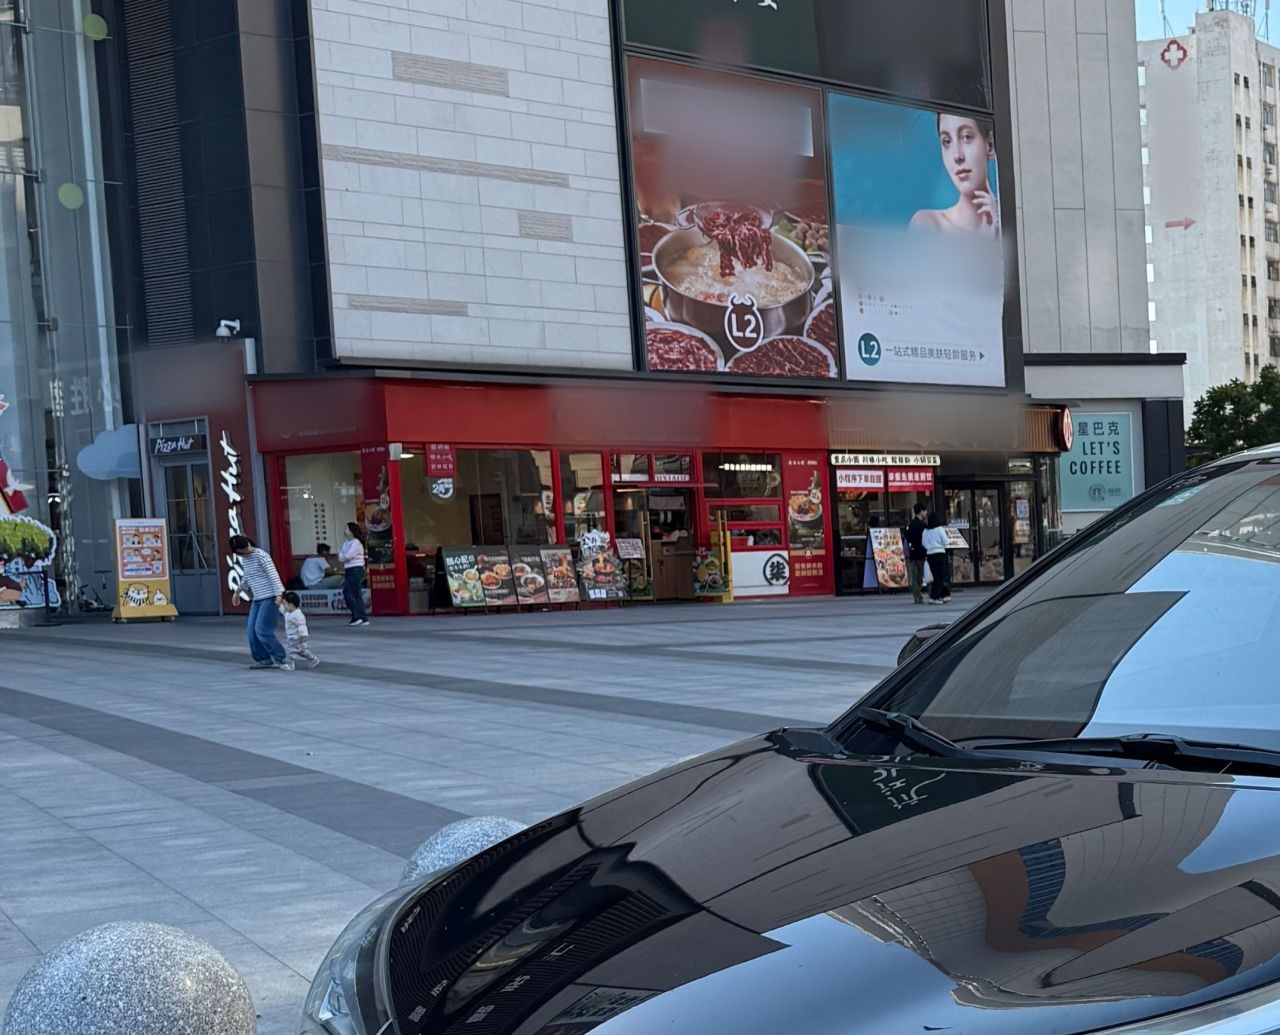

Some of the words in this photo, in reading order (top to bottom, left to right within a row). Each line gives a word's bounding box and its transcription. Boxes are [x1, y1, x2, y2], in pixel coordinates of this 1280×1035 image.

[730, 312, 758, 338] L2
[860, 340, 879, 359] L2
[1077, 421, 1120, 436] 星巴克
[154, 438, 177, 454] Pizza
[177, 437, 194, 450] Hut
[1082, 441, 1120, 456] LET'S
[219, 430, 242, 504] Hut
[1069, 460, 1122, 475] COFFEE
[769, 561, 788, 582] 柒
